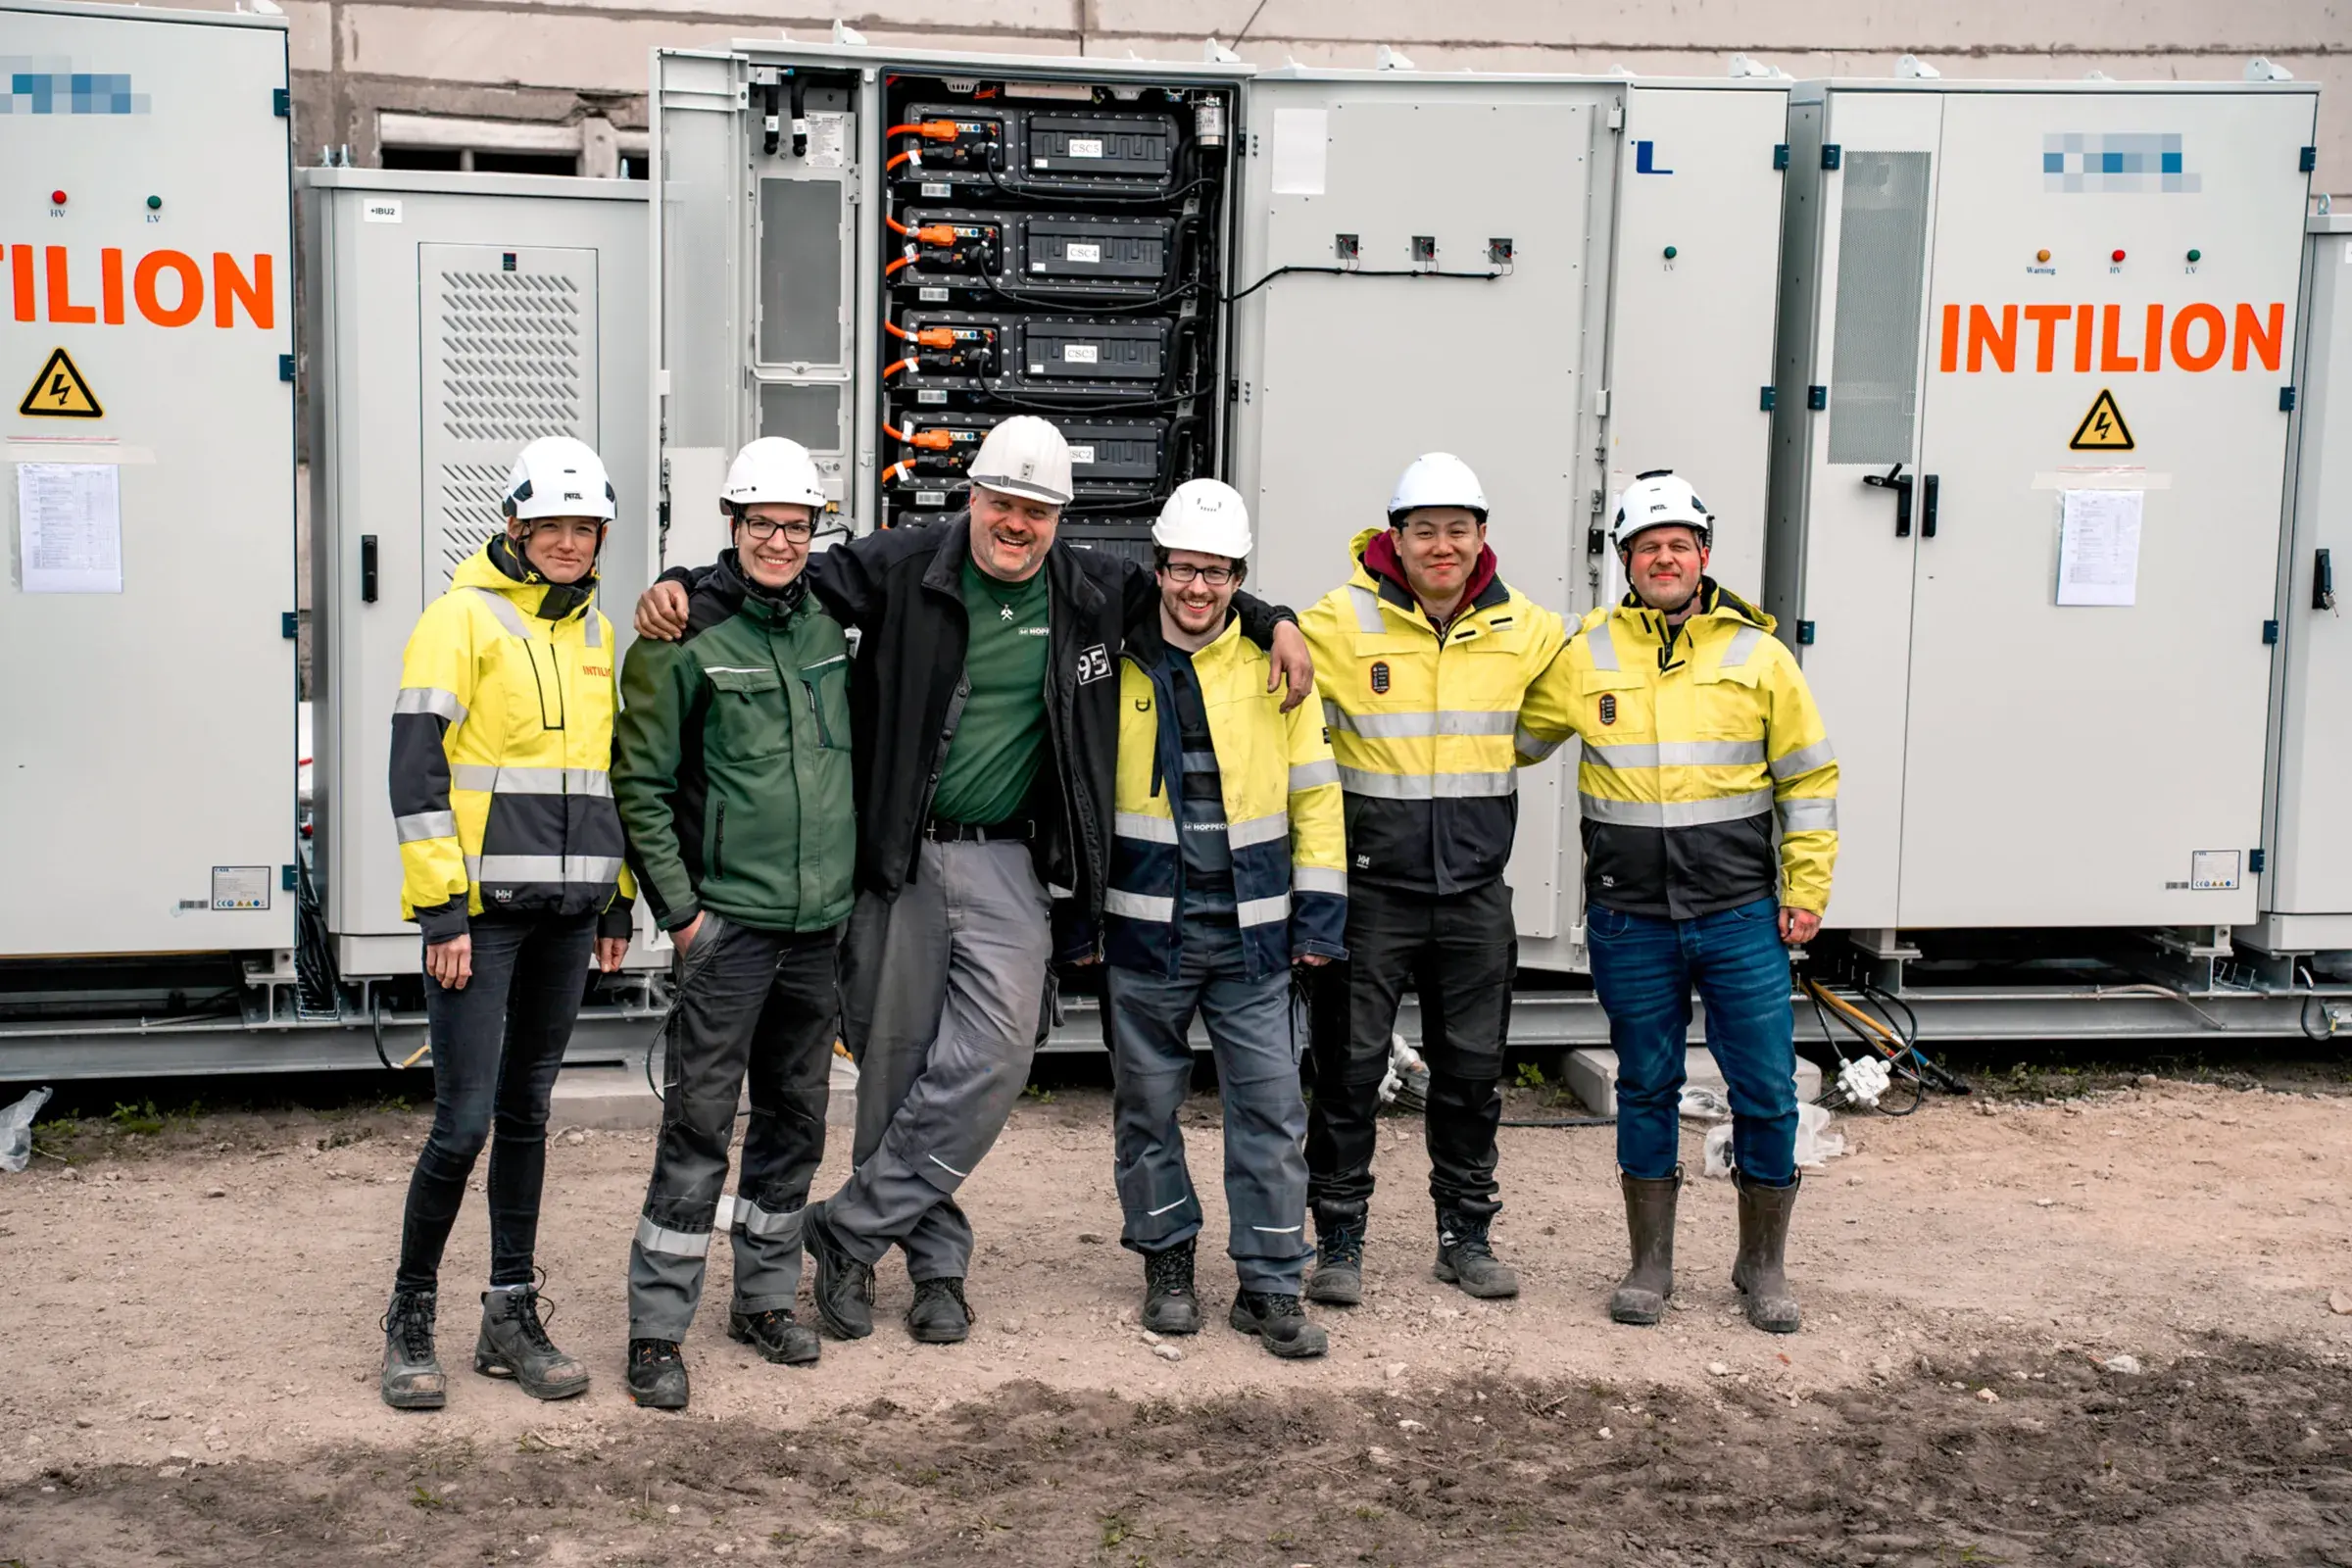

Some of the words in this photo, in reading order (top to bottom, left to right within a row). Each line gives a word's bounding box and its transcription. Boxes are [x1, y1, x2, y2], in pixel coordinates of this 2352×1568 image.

[1071, 143, 1100, 153] CSC5
[50, 209, 66, 218] HV
[147, 215, 161, 223] LV
[2026, 267, 2056, 275] Warning
[0, 244, 274, 329] ILION
[1940, 303, 2285, 373] INTILION
[1067, 349, 1096, 359] CSC3
[1078, 649, 1107, 680] 95
